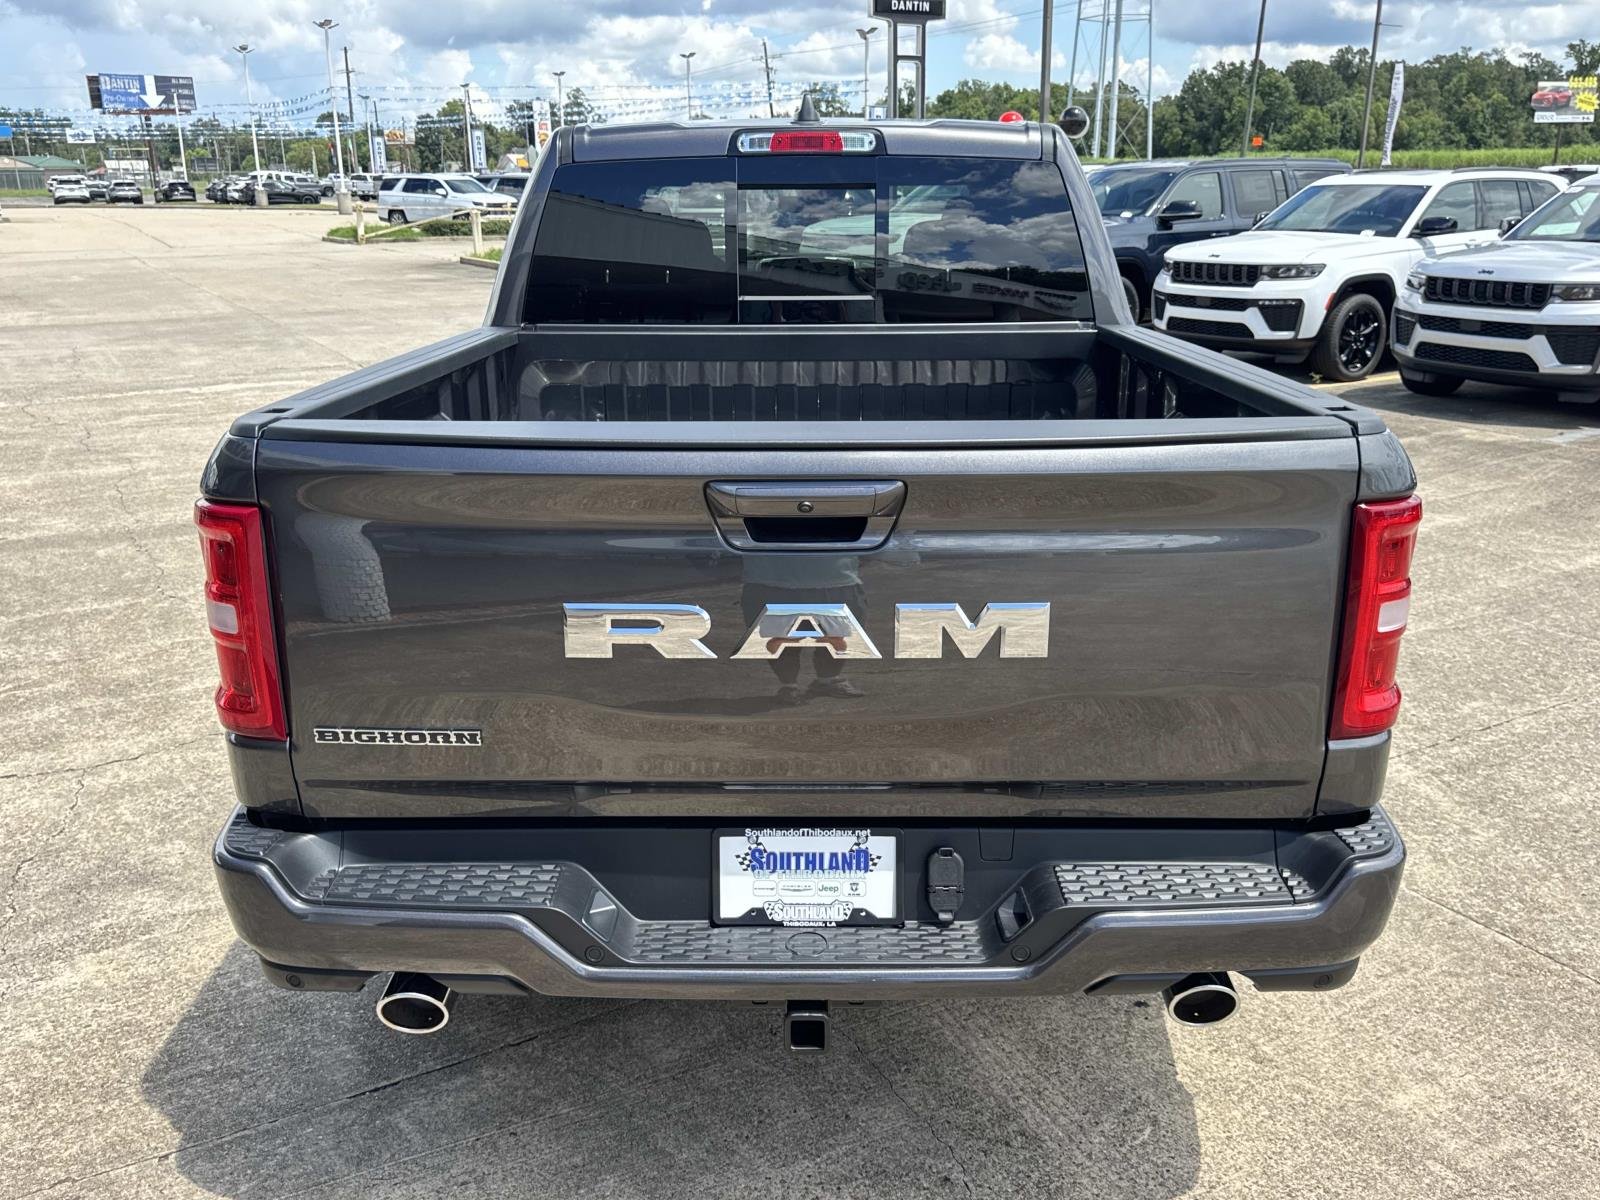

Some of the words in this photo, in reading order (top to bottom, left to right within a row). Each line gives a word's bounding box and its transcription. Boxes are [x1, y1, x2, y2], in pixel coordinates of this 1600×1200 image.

[891, 0, 930, 12] DANTIN
[99, 75, 140, 90] DANTIN
[563, 602, 1051, 658] RAM
[314, 728, 482, 746] BIGHORN
[745, 828, 871, 837] SouthlandofThibodaux.net
[750, 847, 870, 874] SOUTHLAND
[818, 884, 839, 893] Jeep
[774, 903, 844, 920] SOUTHLAND
[827, 920, 837, 928] LA
